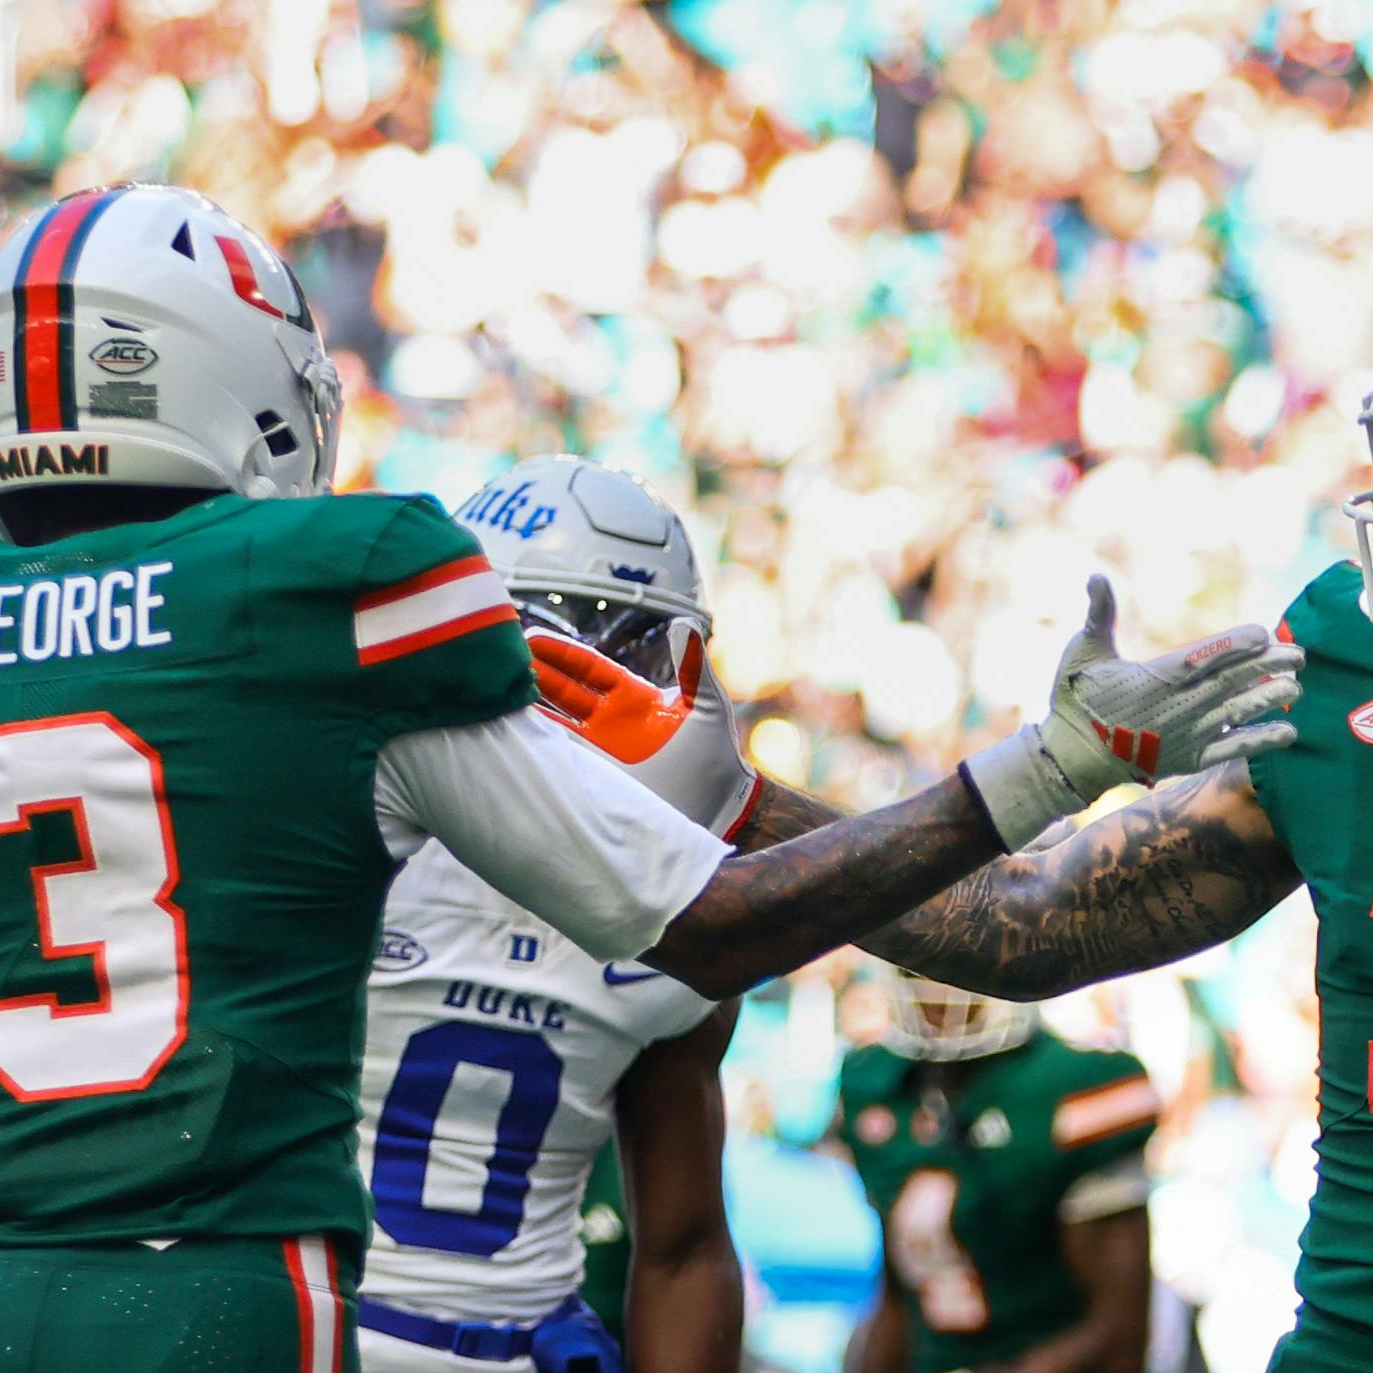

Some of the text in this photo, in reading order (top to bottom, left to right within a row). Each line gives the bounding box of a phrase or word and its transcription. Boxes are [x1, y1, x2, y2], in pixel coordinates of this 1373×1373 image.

[99, 345, 148, 361] ACC
[465, 479, 559, 540] uke
[1184, 635, 1232, 667] ADIZERO
[441, 979, 572, 1030] DUKE
[370, 1020, 564, 1259] 0
